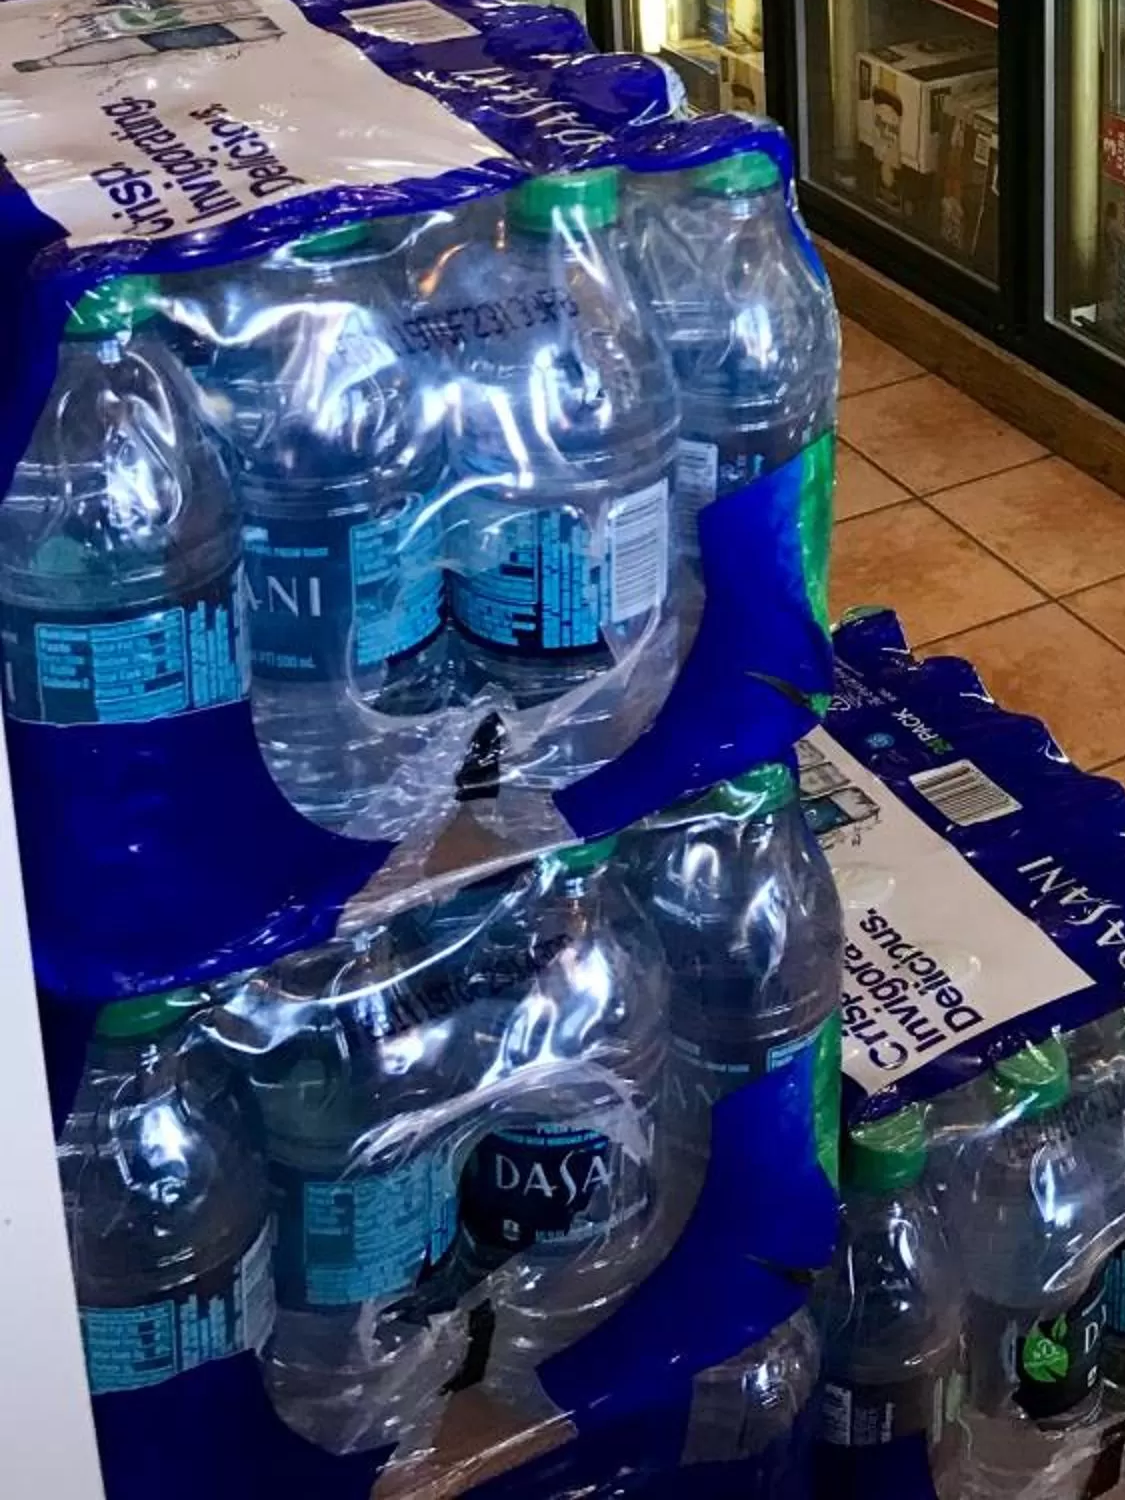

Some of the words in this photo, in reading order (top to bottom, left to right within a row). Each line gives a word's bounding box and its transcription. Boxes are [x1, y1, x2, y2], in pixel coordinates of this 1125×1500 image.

[101, 94, 246, 227] Invigorating.
[893, 705, 932, 742] PACK
[860, 907, 985, 1034] Delicious.
[495, 1154, 613, 1204] DASA
